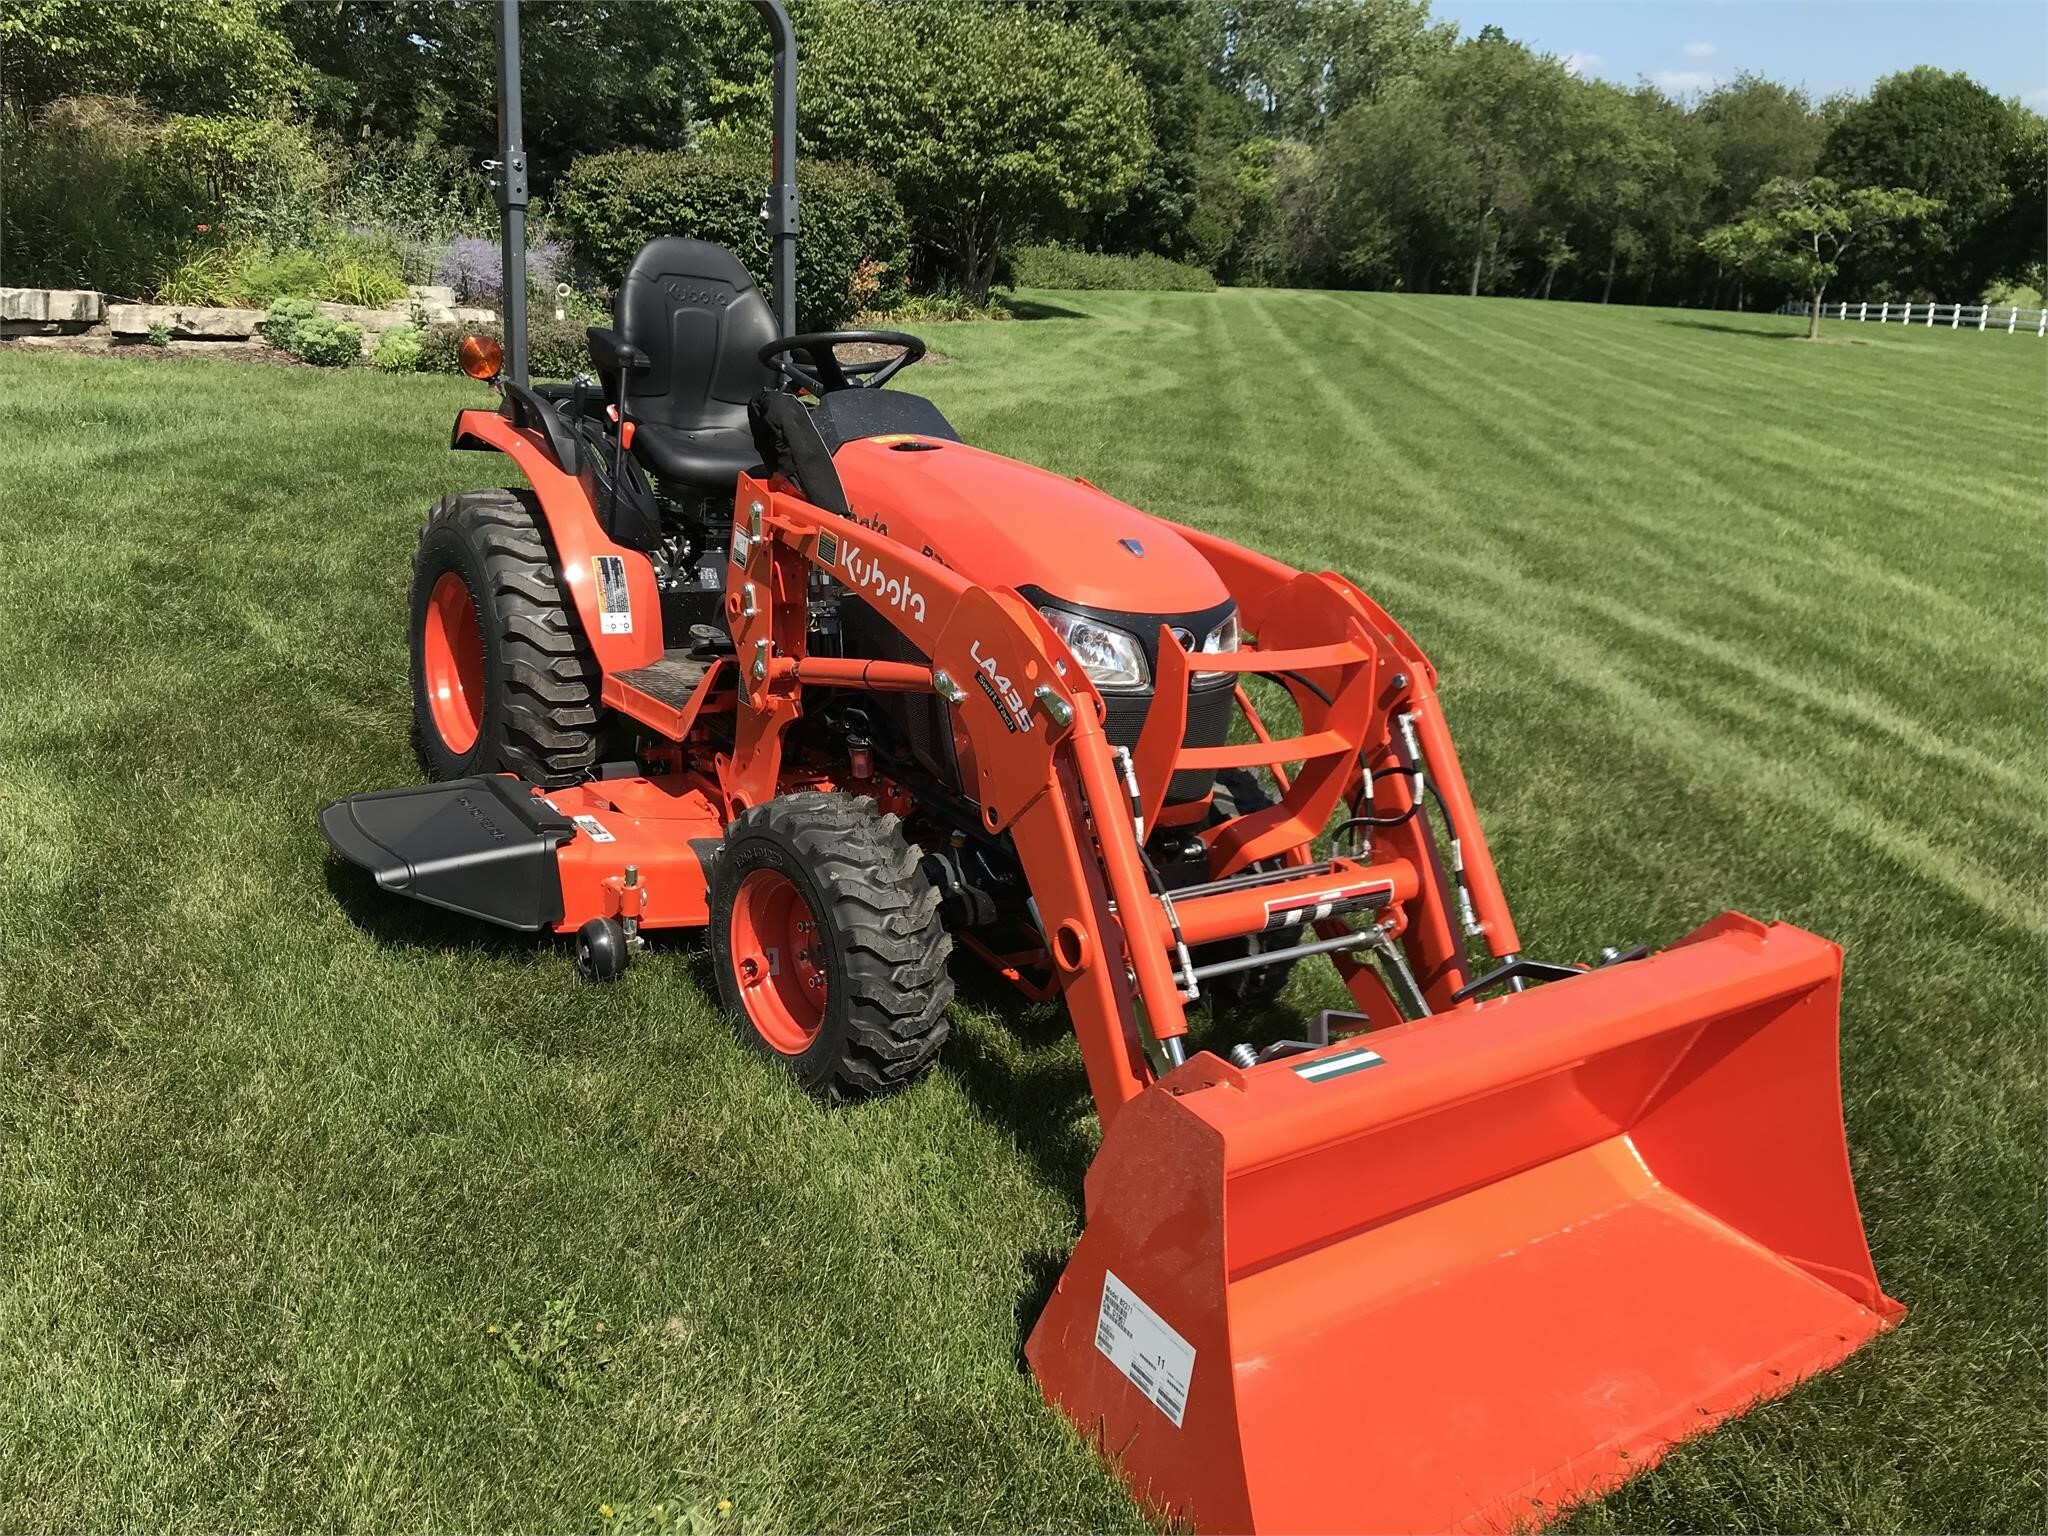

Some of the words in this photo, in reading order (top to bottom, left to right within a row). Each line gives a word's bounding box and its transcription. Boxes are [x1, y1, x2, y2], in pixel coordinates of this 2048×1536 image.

[664, 282, 728, 306] Kubota
[842, 540, 926, 624] Kubota
[970, 639, 1035, 733] LA435
[977, 673, 1015, 731] Swift-Tach
